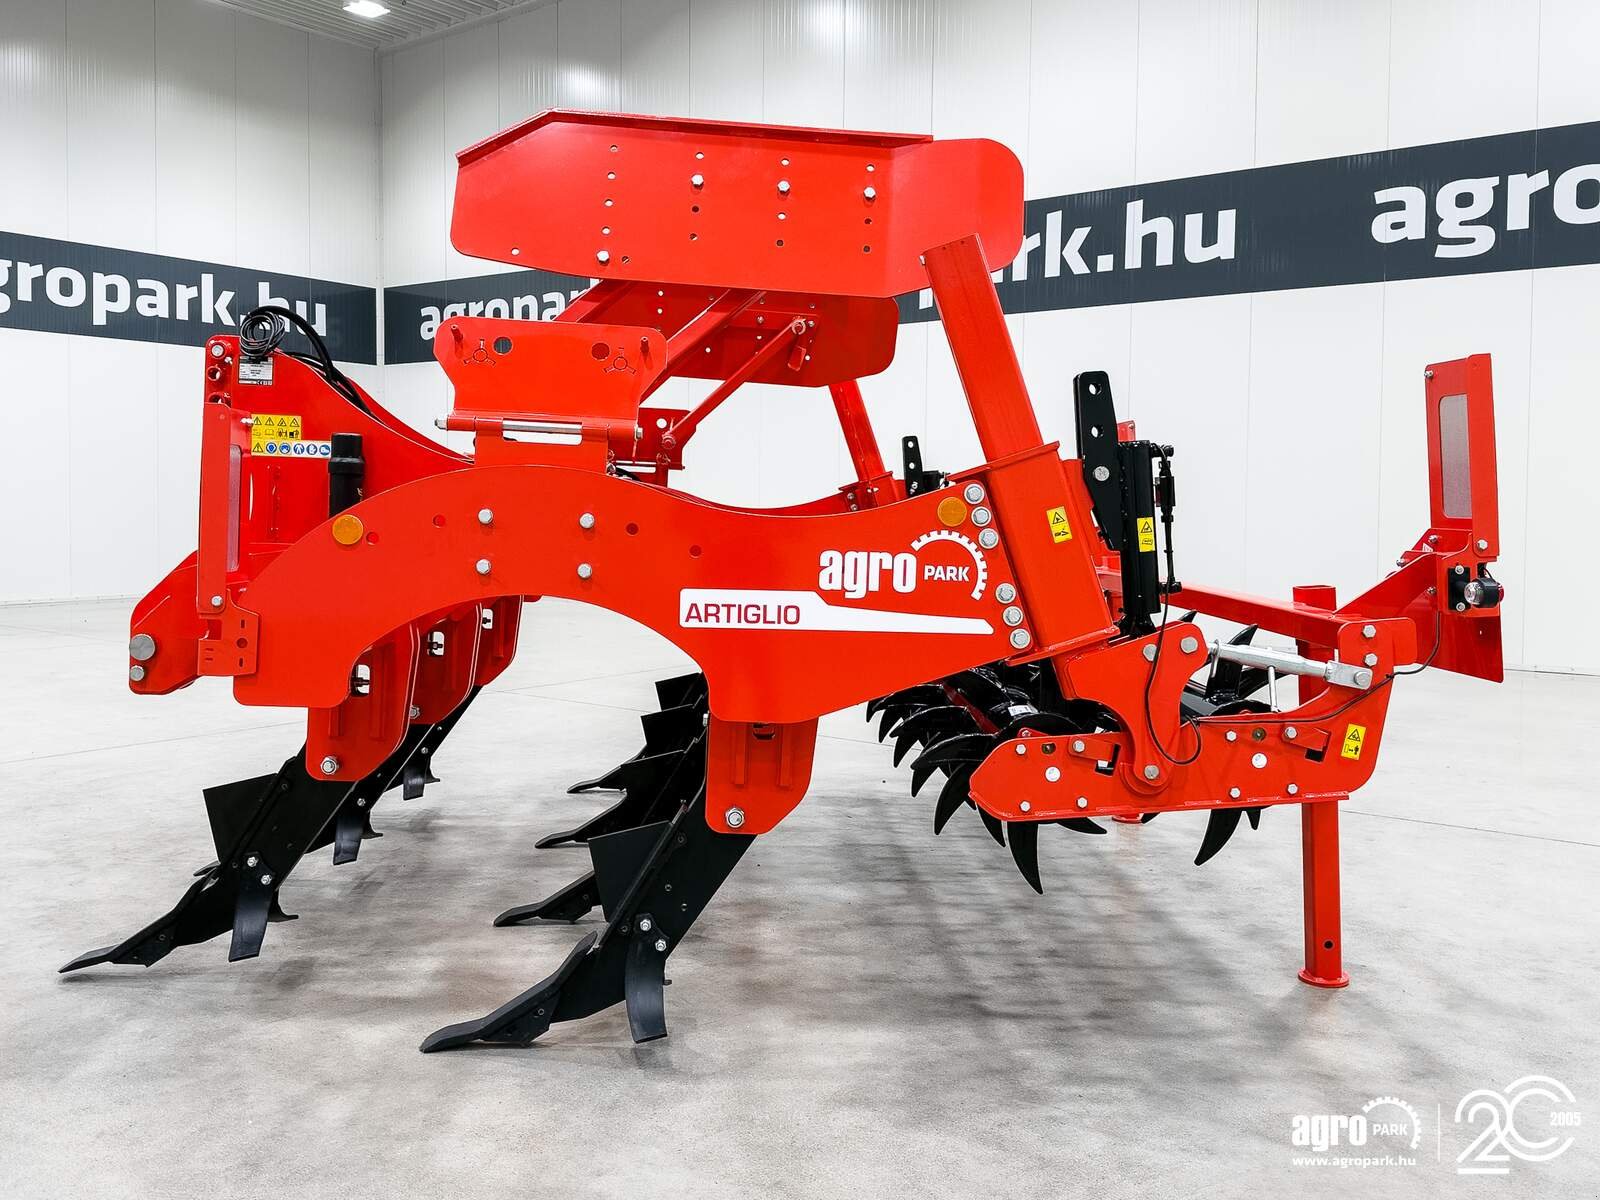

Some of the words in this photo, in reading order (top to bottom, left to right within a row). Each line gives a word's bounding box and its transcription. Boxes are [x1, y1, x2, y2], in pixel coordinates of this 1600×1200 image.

[819, 550, 917, 599] agro
[923, 565, 970, 582] PARK
[685, 602, 801, 625] ARTIGLIO
